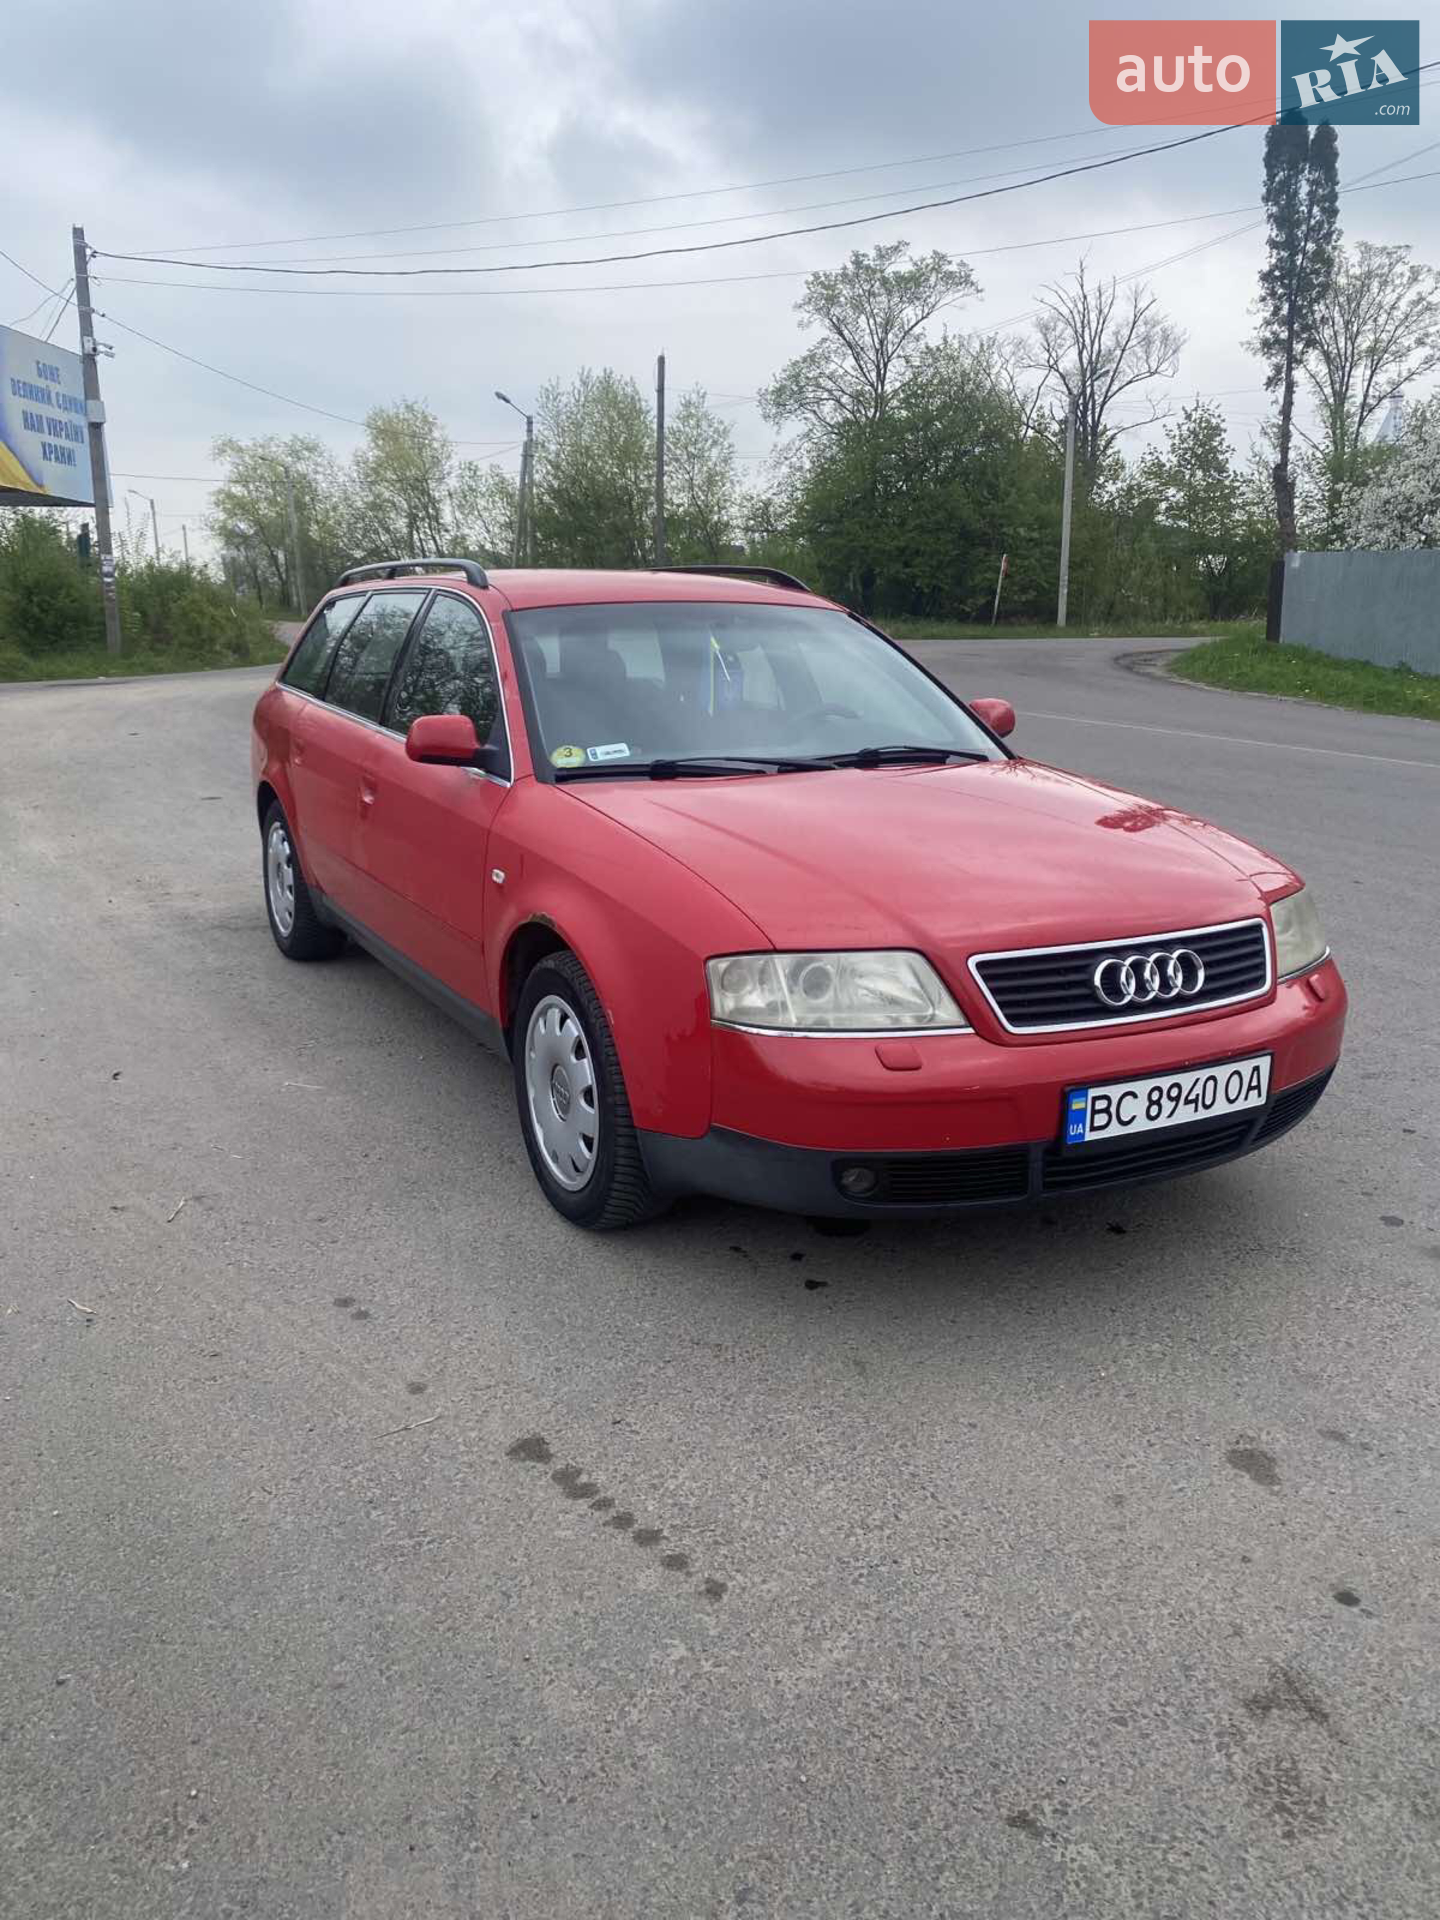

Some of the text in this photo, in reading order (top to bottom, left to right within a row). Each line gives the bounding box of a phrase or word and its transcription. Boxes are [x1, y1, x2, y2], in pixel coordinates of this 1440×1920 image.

[36, 360, 60, 384] БОЖЕ
[563, 747, 573, 758] 3
[1089, 1090, 1138, 1132] BC
[1145, 1074, 1218, 1122] 8940
[1069, 1123, 1084, 1135] UA
